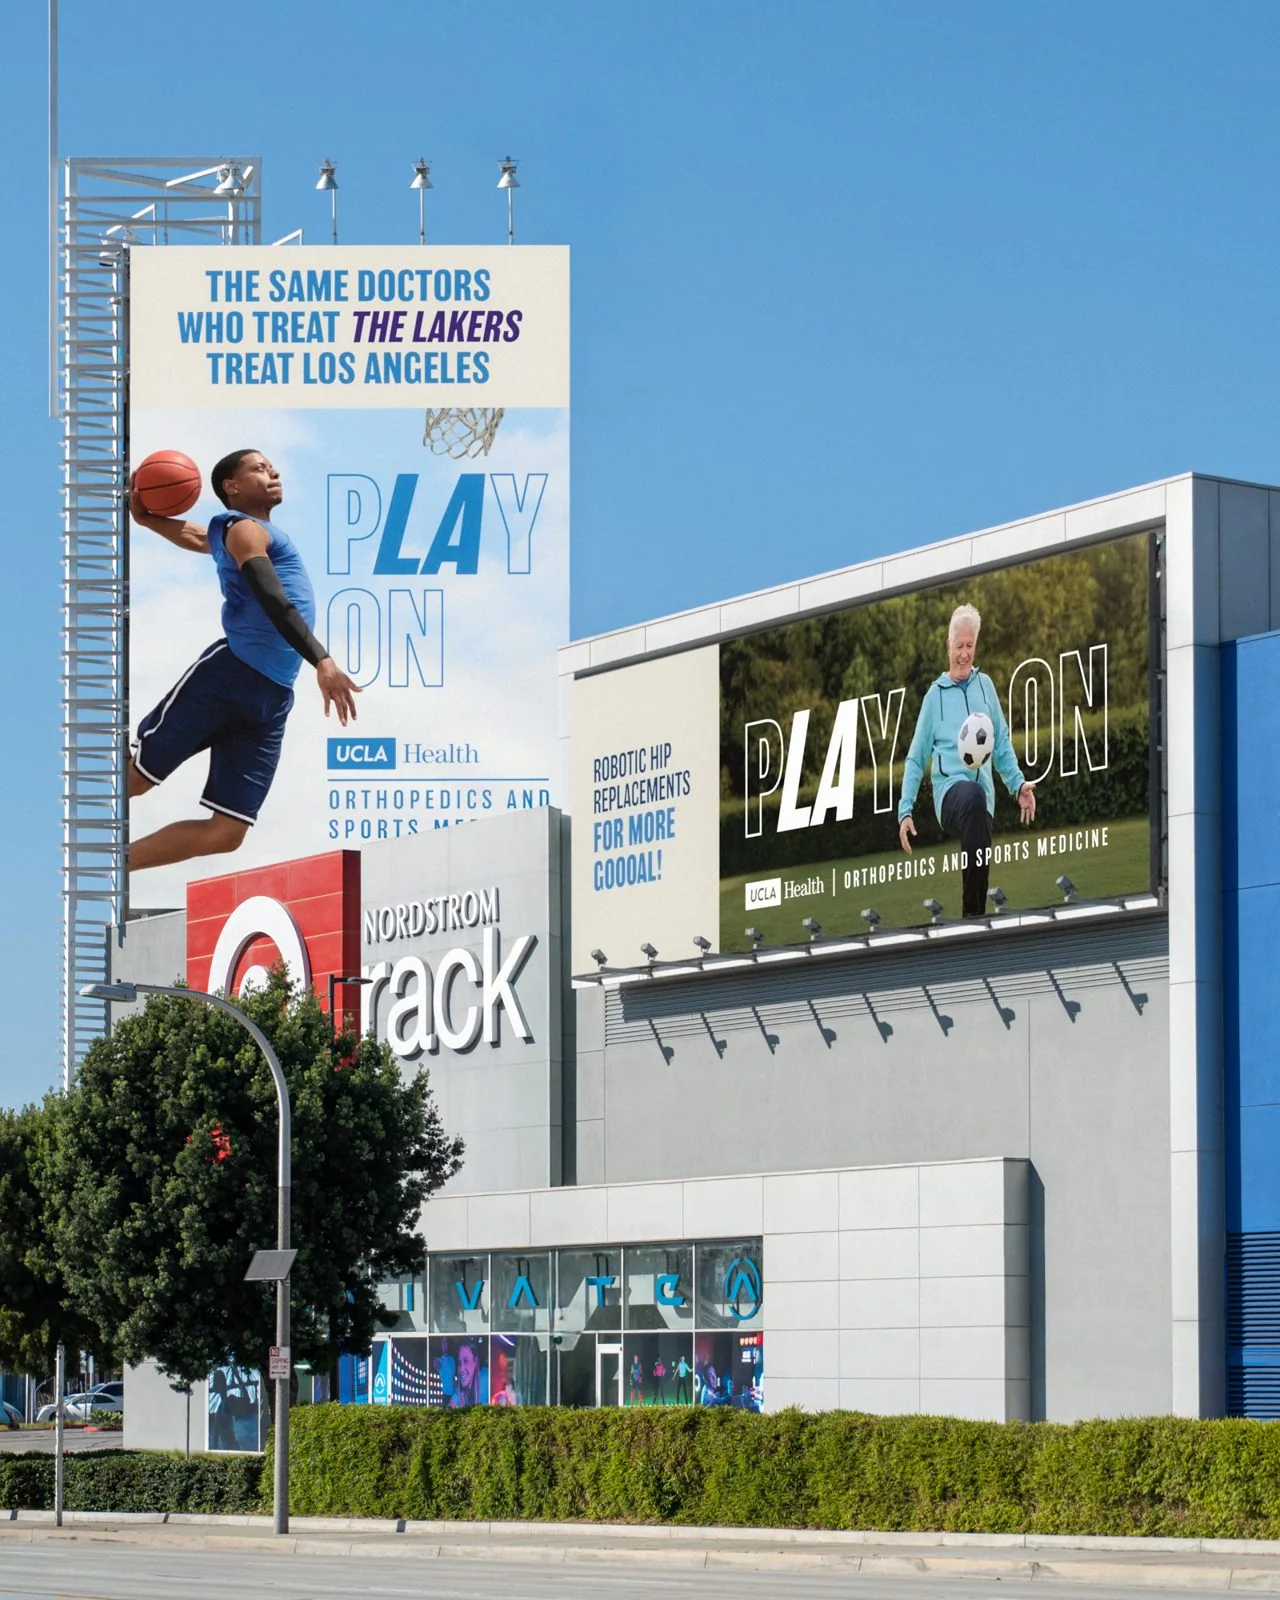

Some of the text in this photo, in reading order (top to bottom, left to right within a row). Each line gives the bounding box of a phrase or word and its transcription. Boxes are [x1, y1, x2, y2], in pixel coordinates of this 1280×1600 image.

[205, 269, 491, 302] THE SAME DOCTORS
[177, 310, 523, 343] WHO TREAT THE LAKERS
[206, 351, 490, 384] TREAT LOS ANGELES
[327, 473, 549, 576] PLAY
[327, 588, 444, 688] ON
[336, 744, 479, 764] UCLA Health
[594, 742, 672, 783] ROBOTIC HIP
[744, 643, 1109, 839] PLAY ON
[329, 789, 549, 810] ORTHOPEDICS AND
[594, 769, 691, 814] REPLACEMENTS
[329, 818, 418, 839] SPORTS
[594, 806, 676, 853] FOR MORE
[594, 848, 662, 892] GOOOAL!
[750, 827, 1109, 903] UCLA Health ORTHOPEDICS AND SPORTS MEDICINE
[363, 887, 500, 944] NORDSTROM
[360, 927, 539, 1060] rack
